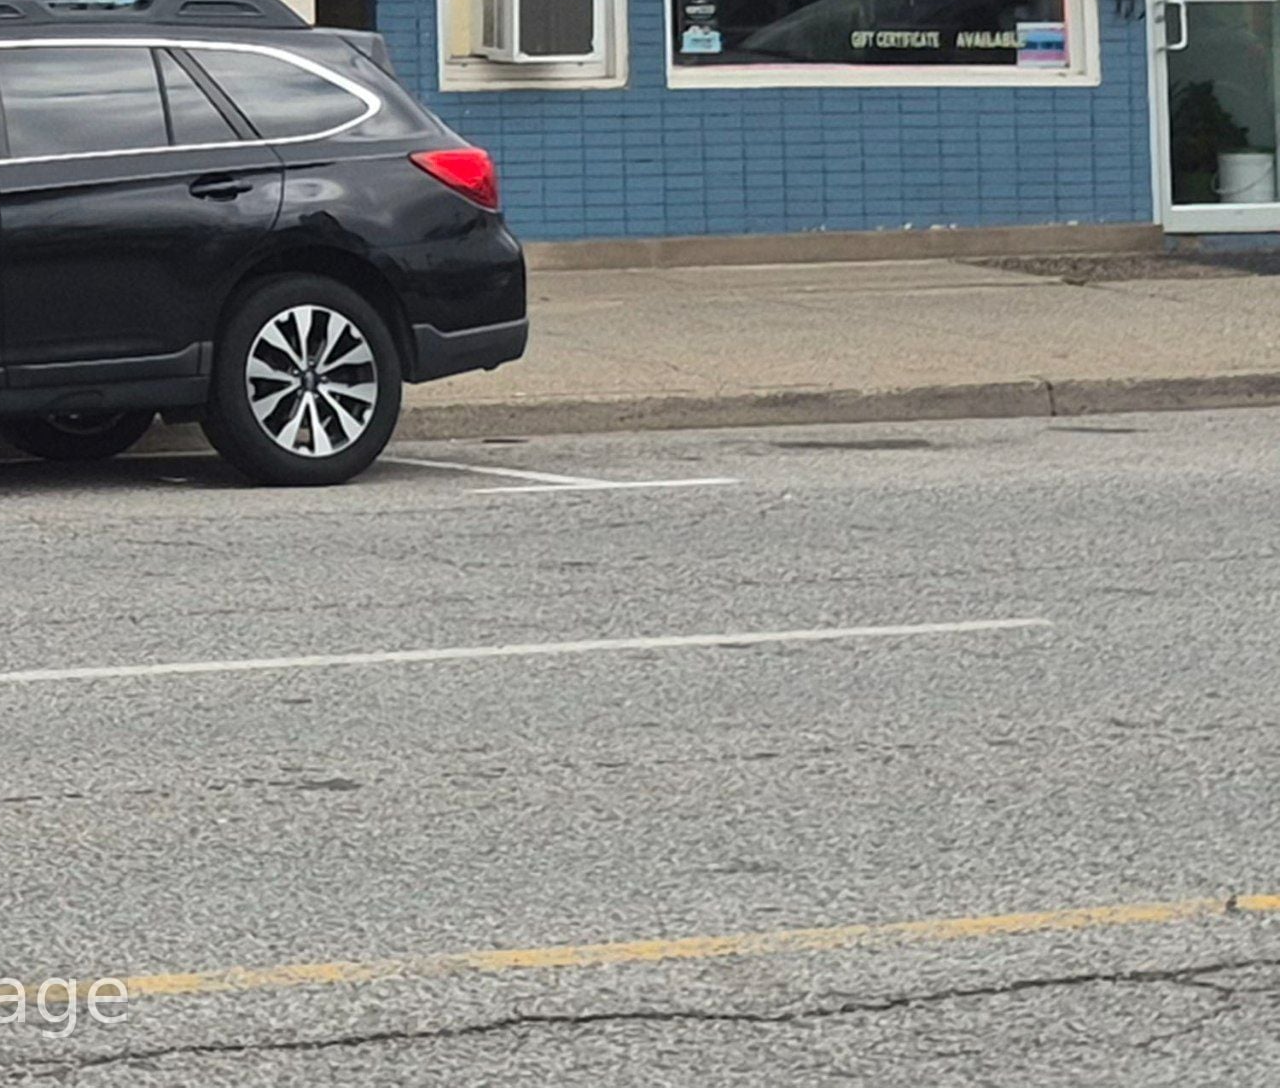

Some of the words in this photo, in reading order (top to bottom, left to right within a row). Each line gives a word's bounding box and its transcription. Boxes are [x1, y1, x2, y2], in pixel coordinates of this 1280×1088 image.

[851, 31, 875, 48] GIFT
[877, 31, 939, 48] CERTIFICATE
[956, 31, 1026, 48] AVAILABLE
